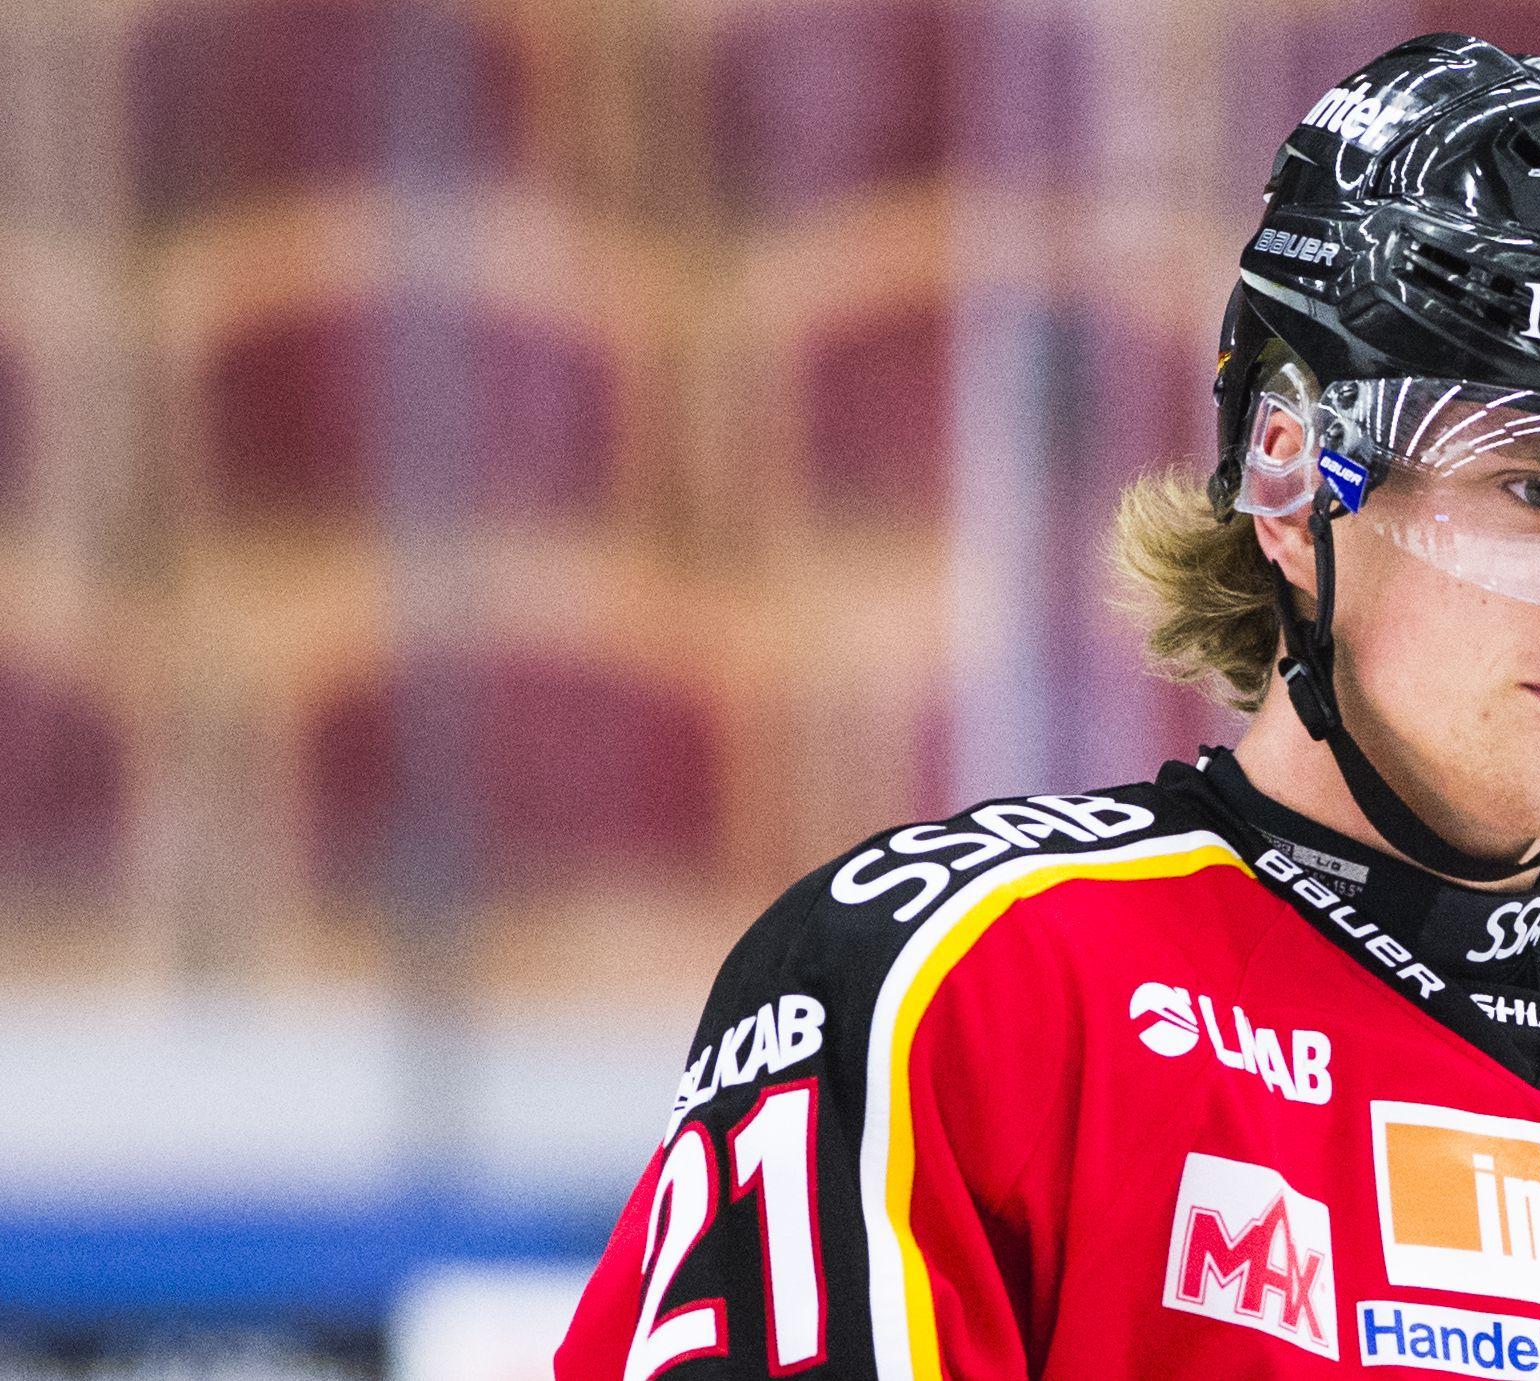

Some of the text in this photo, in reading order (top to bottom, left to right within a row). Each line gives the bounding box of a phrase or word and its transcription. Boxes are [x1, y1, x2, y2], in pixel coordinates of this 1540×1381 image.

[831, 795, 1155, 922] SSAB
[624, 1078, 827, 1381] 21
[1177, 1188, 1329, 1349] MAX
